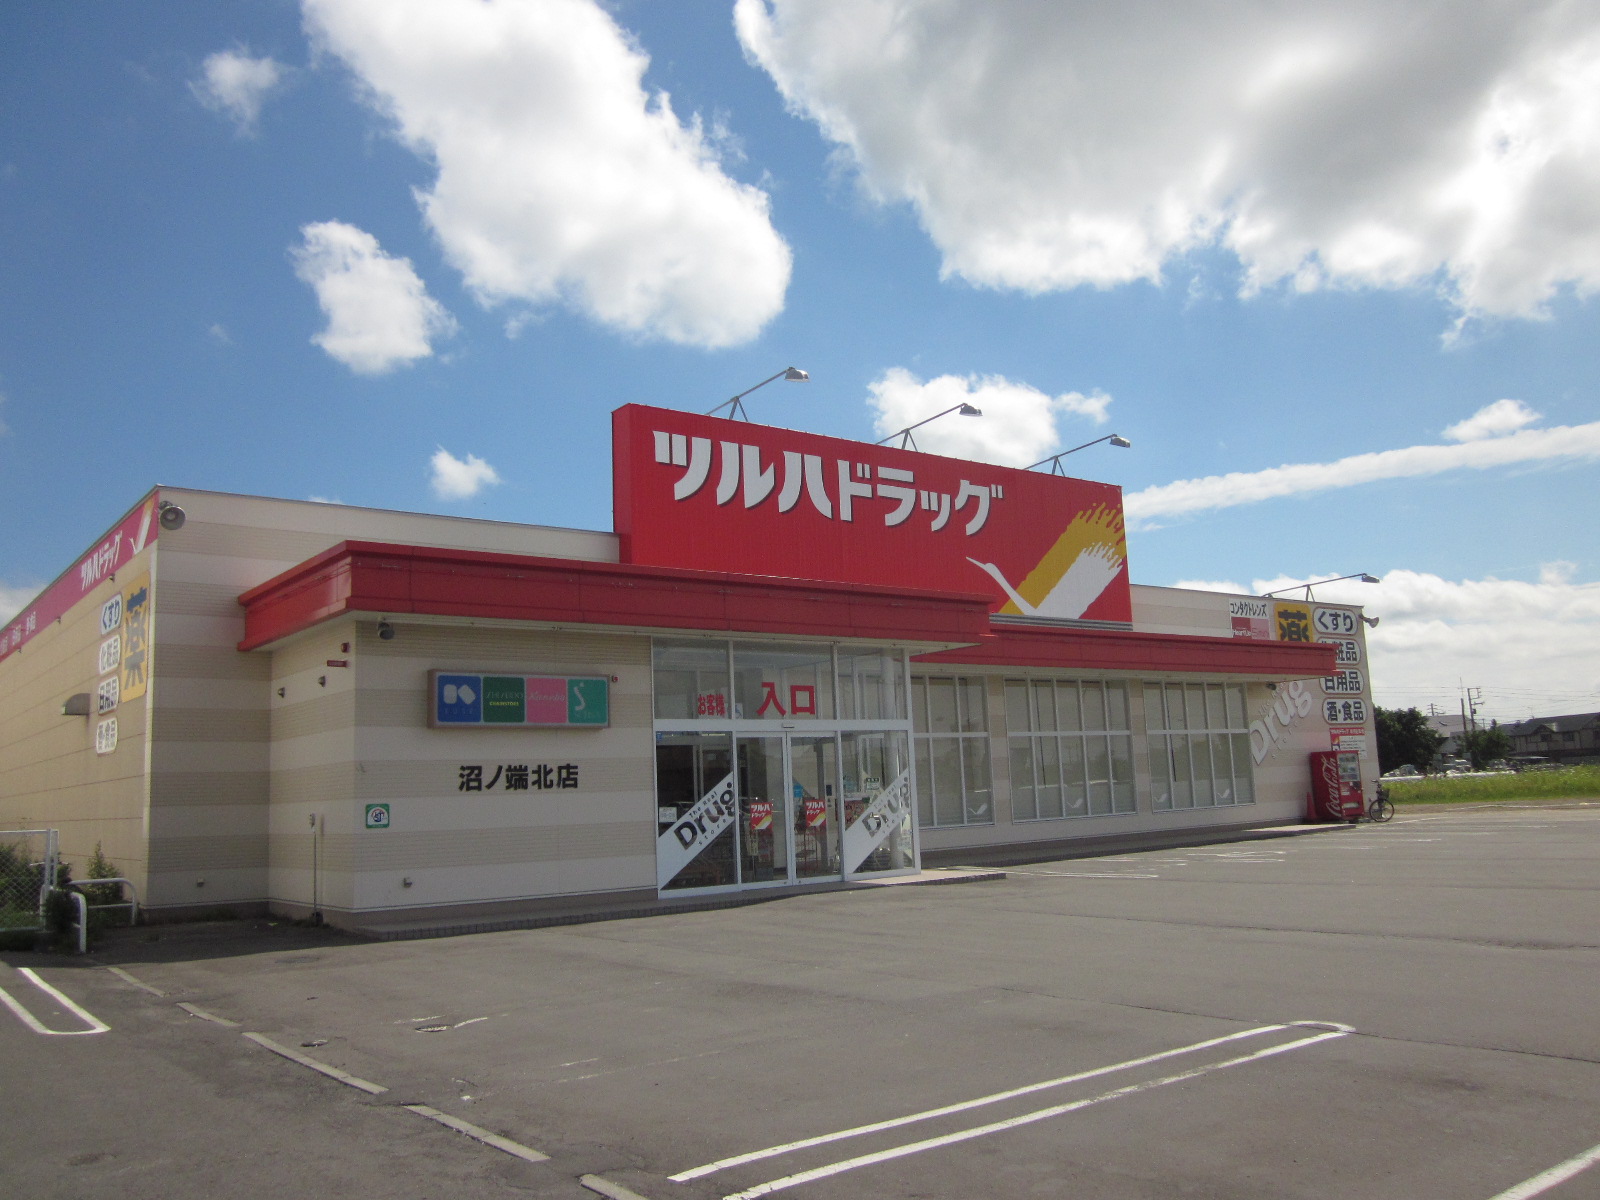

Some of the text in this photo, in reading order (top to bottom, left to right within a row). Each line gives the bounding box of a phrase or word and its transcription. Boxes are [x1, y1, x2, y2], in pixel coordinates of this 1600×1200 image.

[652, 430, 1003, 535] ツルハドラッグ
[81, 530, 122, 591] ツルハドラッグ
[102, 600, 120, 629] くすり
[1230, 601, 1267, 616] コンタクトレンズ
[1318, 611, 1353, 632] くすり
[100, 678, 117, 710] 日用品
[1325, 671, 1361, 691] 日用品
[756, 682, 815, 716] 入口
[1249, 680, 1312, 766] Drug
[458, 763, 579, 791] 沼ノ端北店
[673, 782, 735, 851] Drug
[688, 807, 701, 818] The
[703, 791, 718, 805] Real
[751, 803, 771, 812] ツルハ
[805, 801, 825, 809] ツルハ
[698, 818, 727, 845] store
